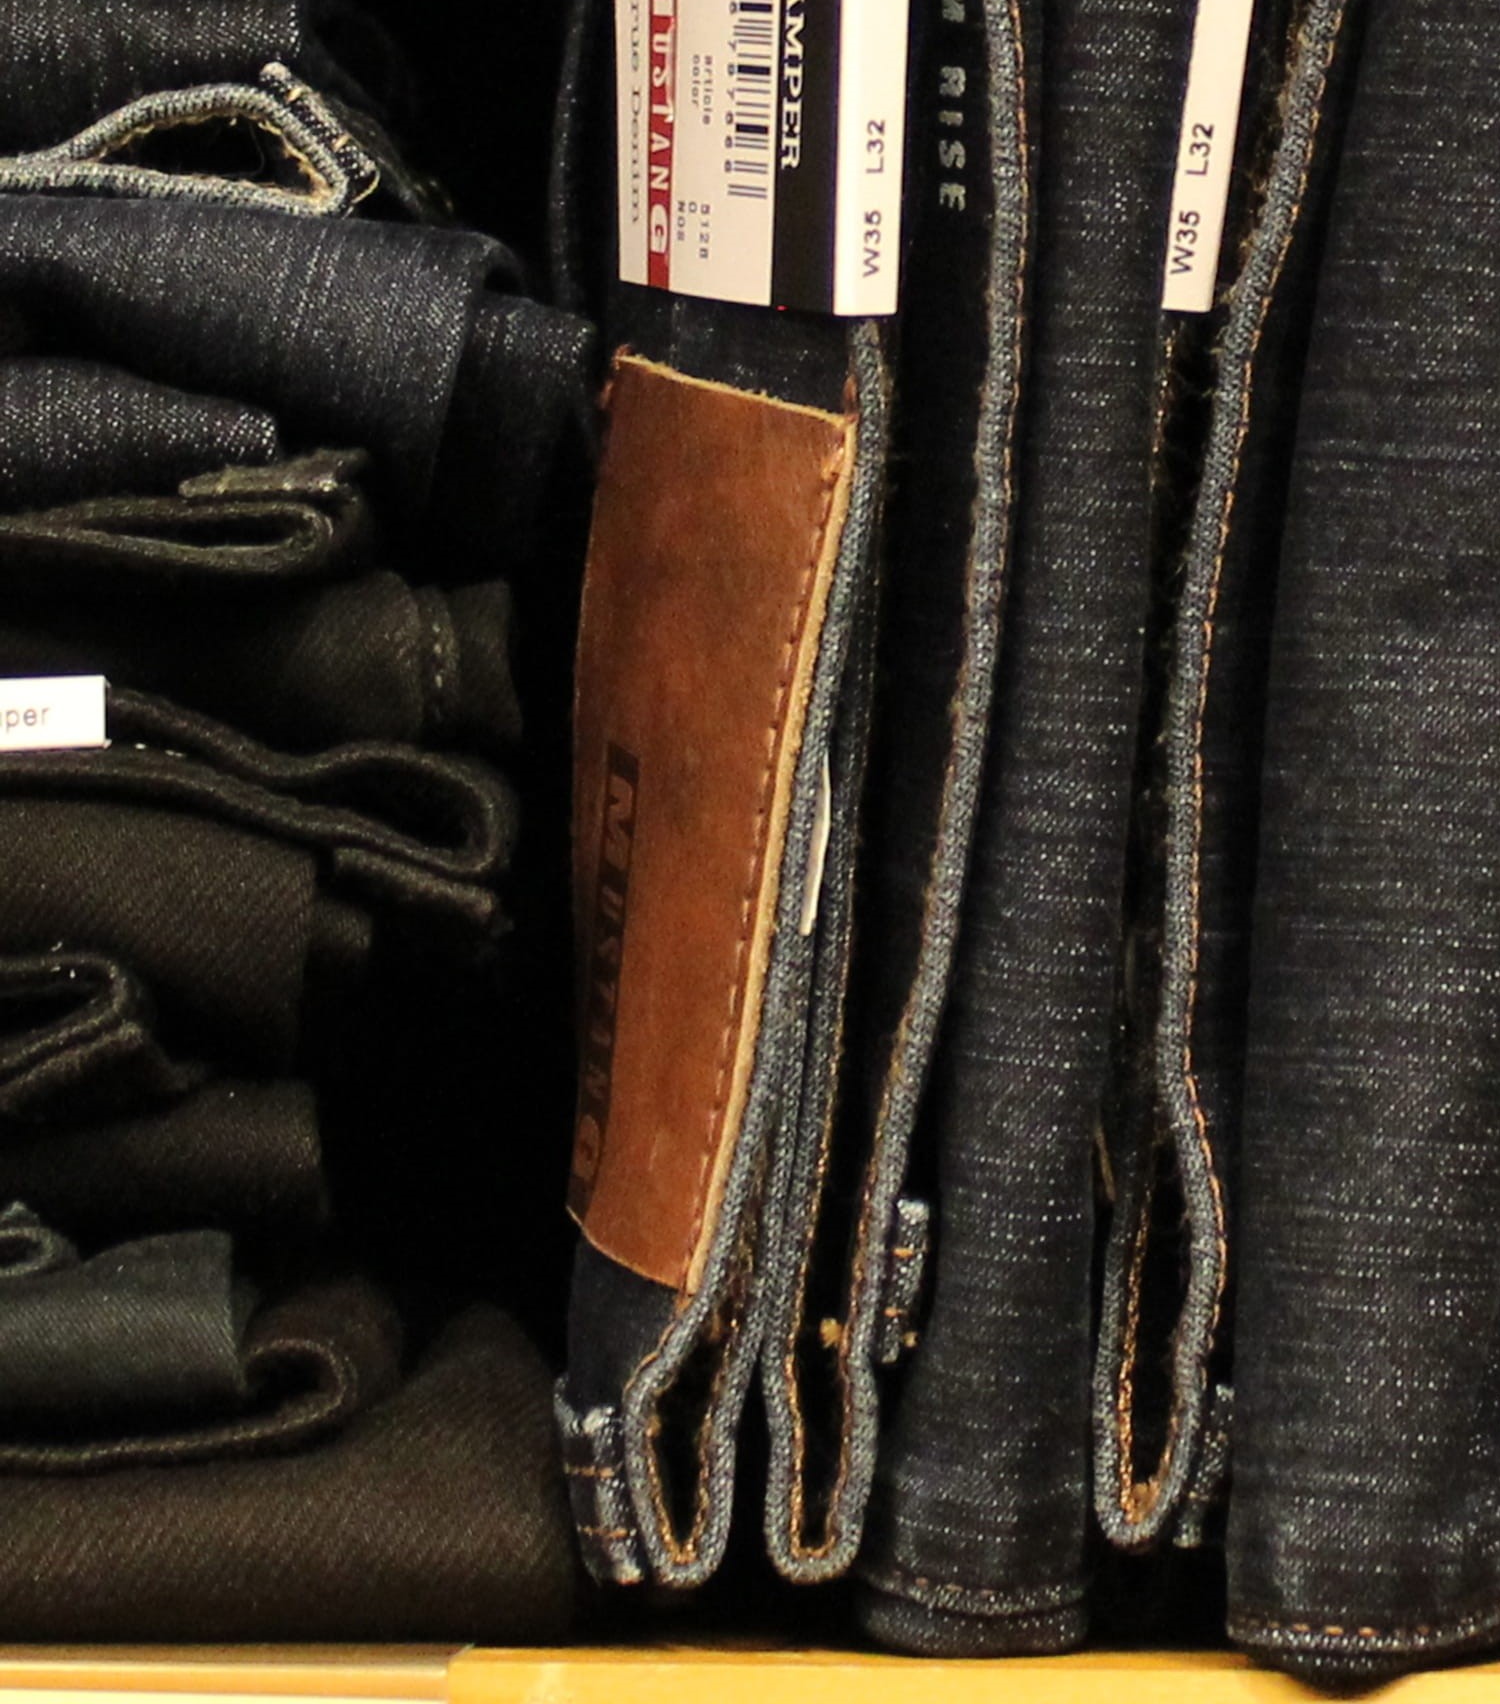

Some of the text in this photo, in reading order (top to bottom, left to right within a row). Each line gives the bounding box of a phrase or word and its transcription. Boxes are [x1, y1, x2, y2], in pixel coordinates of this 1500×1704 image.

[631, 87, 642, 224] Denim
[866, 119, 887, 175] L32
[938, 65, 967, 213] RISE
[1170, 210, 1201, 275] W35
[1186, 121, 1215, 177] L32
[862, 210, 883, 279] W35
[0, 707, 51, 734] per
[575, 774, 634, 1179] MUSTANG
